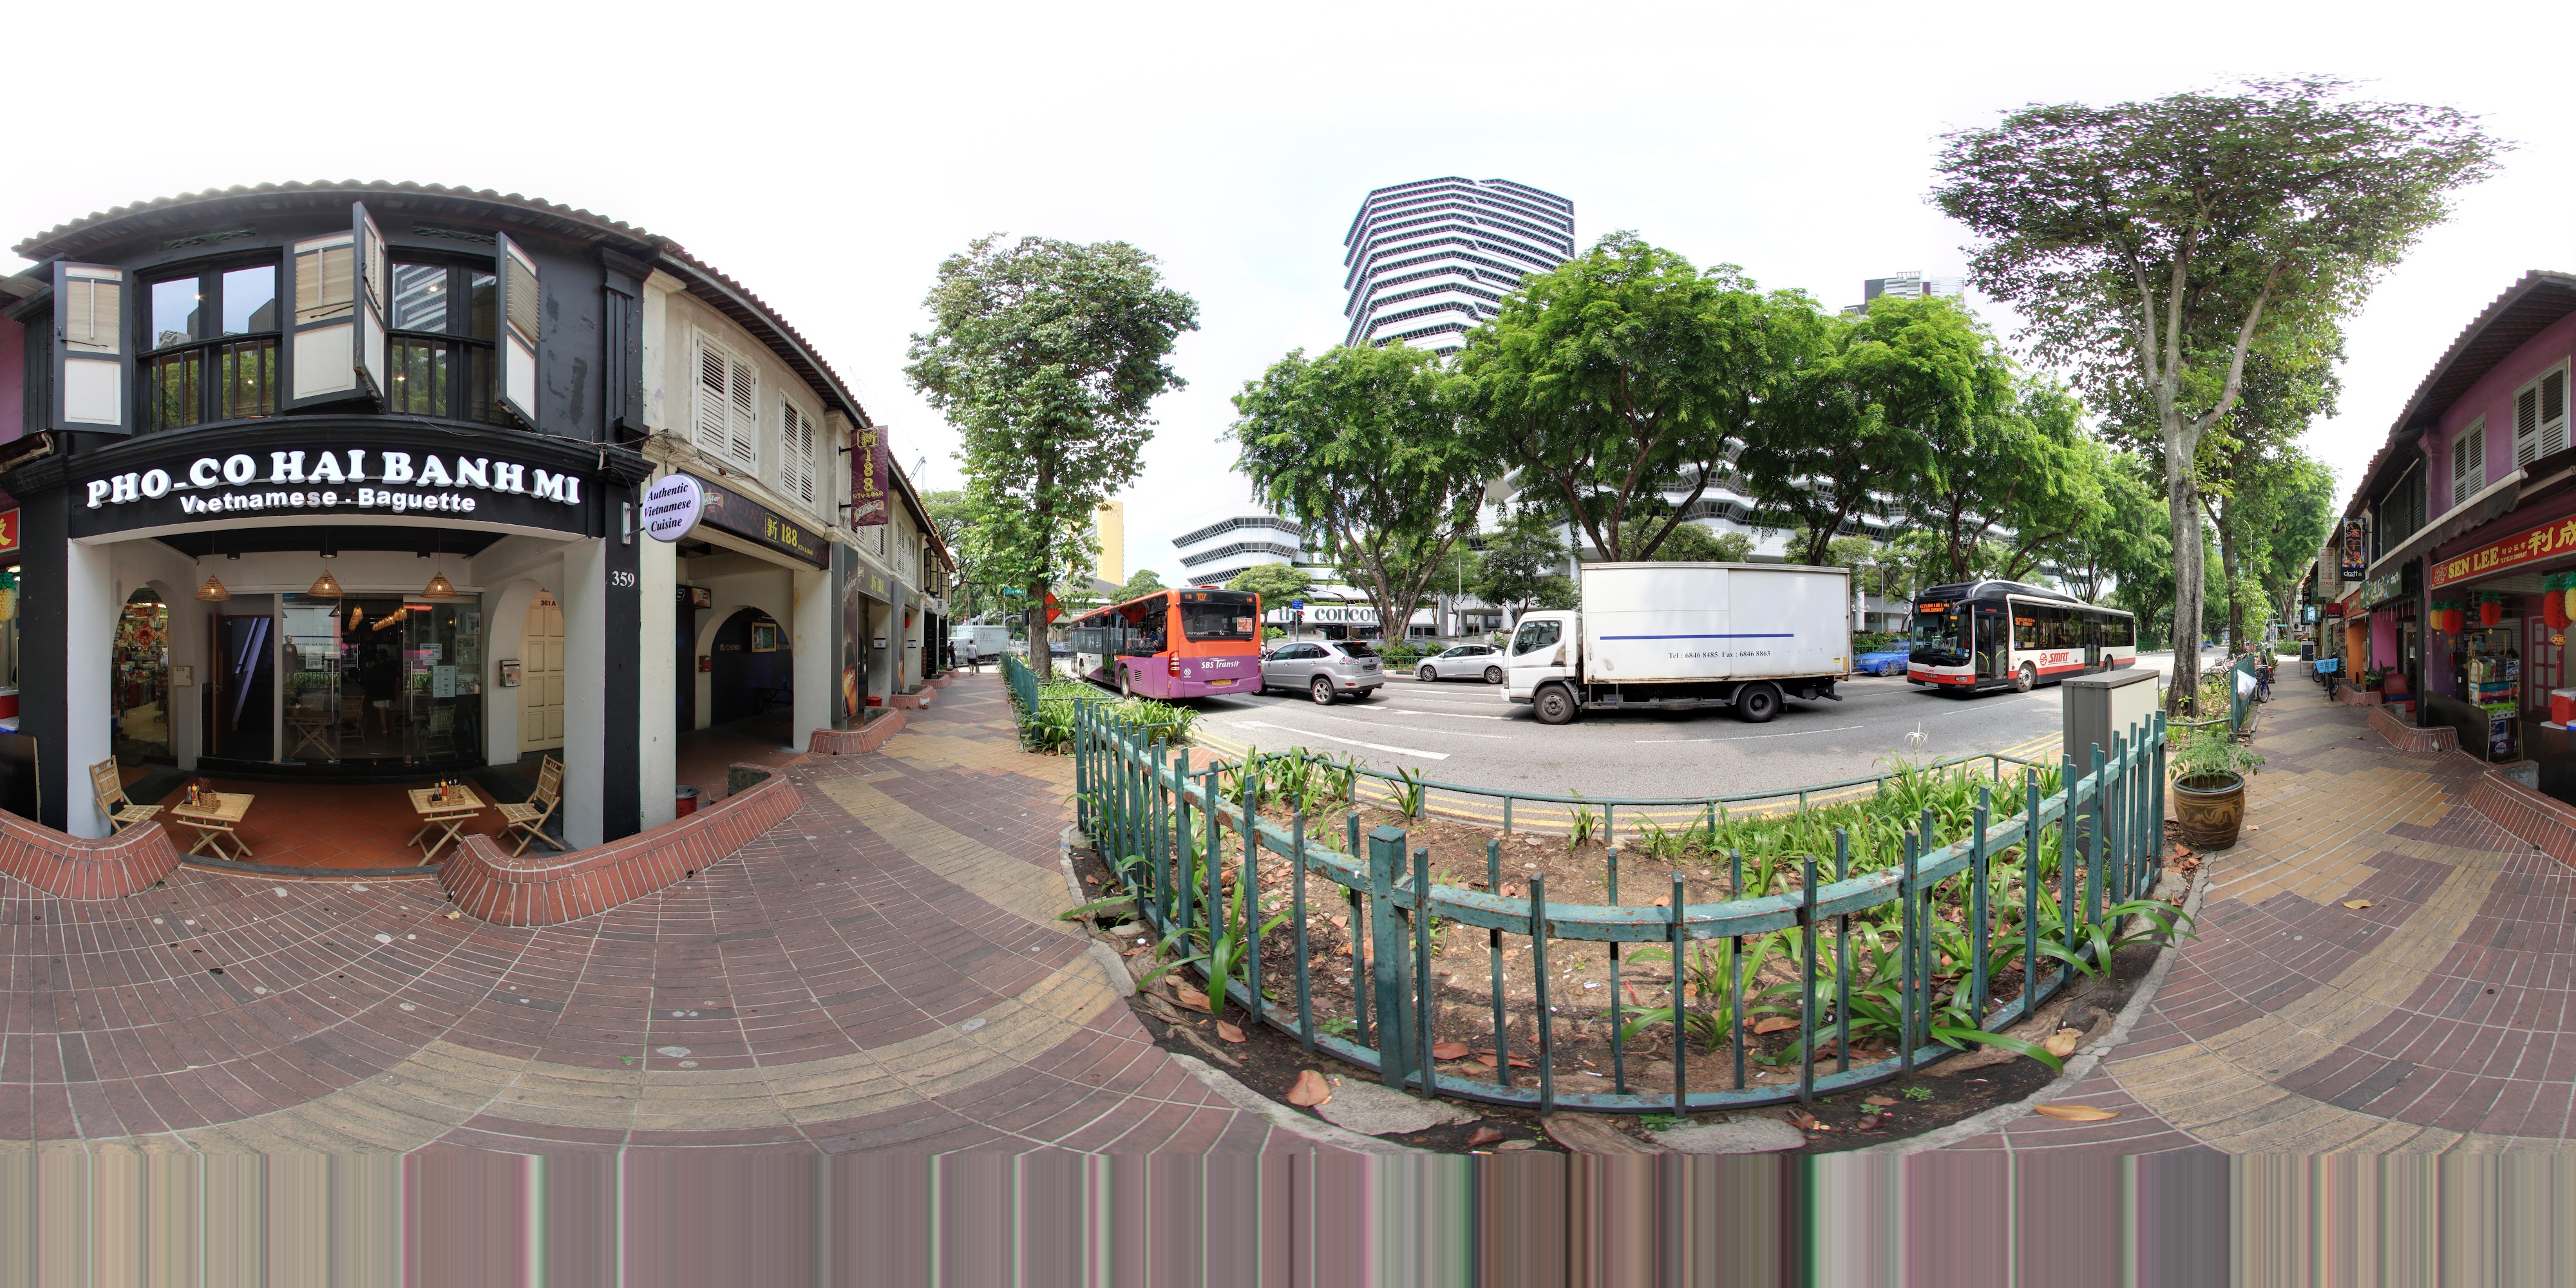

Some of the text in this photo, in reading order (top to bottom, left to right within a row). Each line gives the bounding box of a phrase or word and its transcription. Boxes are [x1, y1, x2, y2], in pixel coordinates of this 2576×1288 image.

[270, 449, 366, 484] HAI
[381, 451, 525, 495] BANH
[531, 468, 580, 506] MI
[864, 448, 873, 492] 188
[358, 488, 476, 513] Baguette
[647, 482, 688, 502] Authentic
[644, 500, 692, 518] Vietnamese
[651, 517, 683, 532] Cuisine
[766, 516, 779, 540] 新
[781, 523, 798, 547] 188
[2448, 545, 2499, 579] SEN LEE
[2500, 551, 2528, 564] TEXTILES COMPANY
[612, 571, 635, 587] 359
[1196, 592, 1208, 601] 107
[1213, 658, 1240, 669] Transit
[2048, 652, 2070, 663] SMRT
